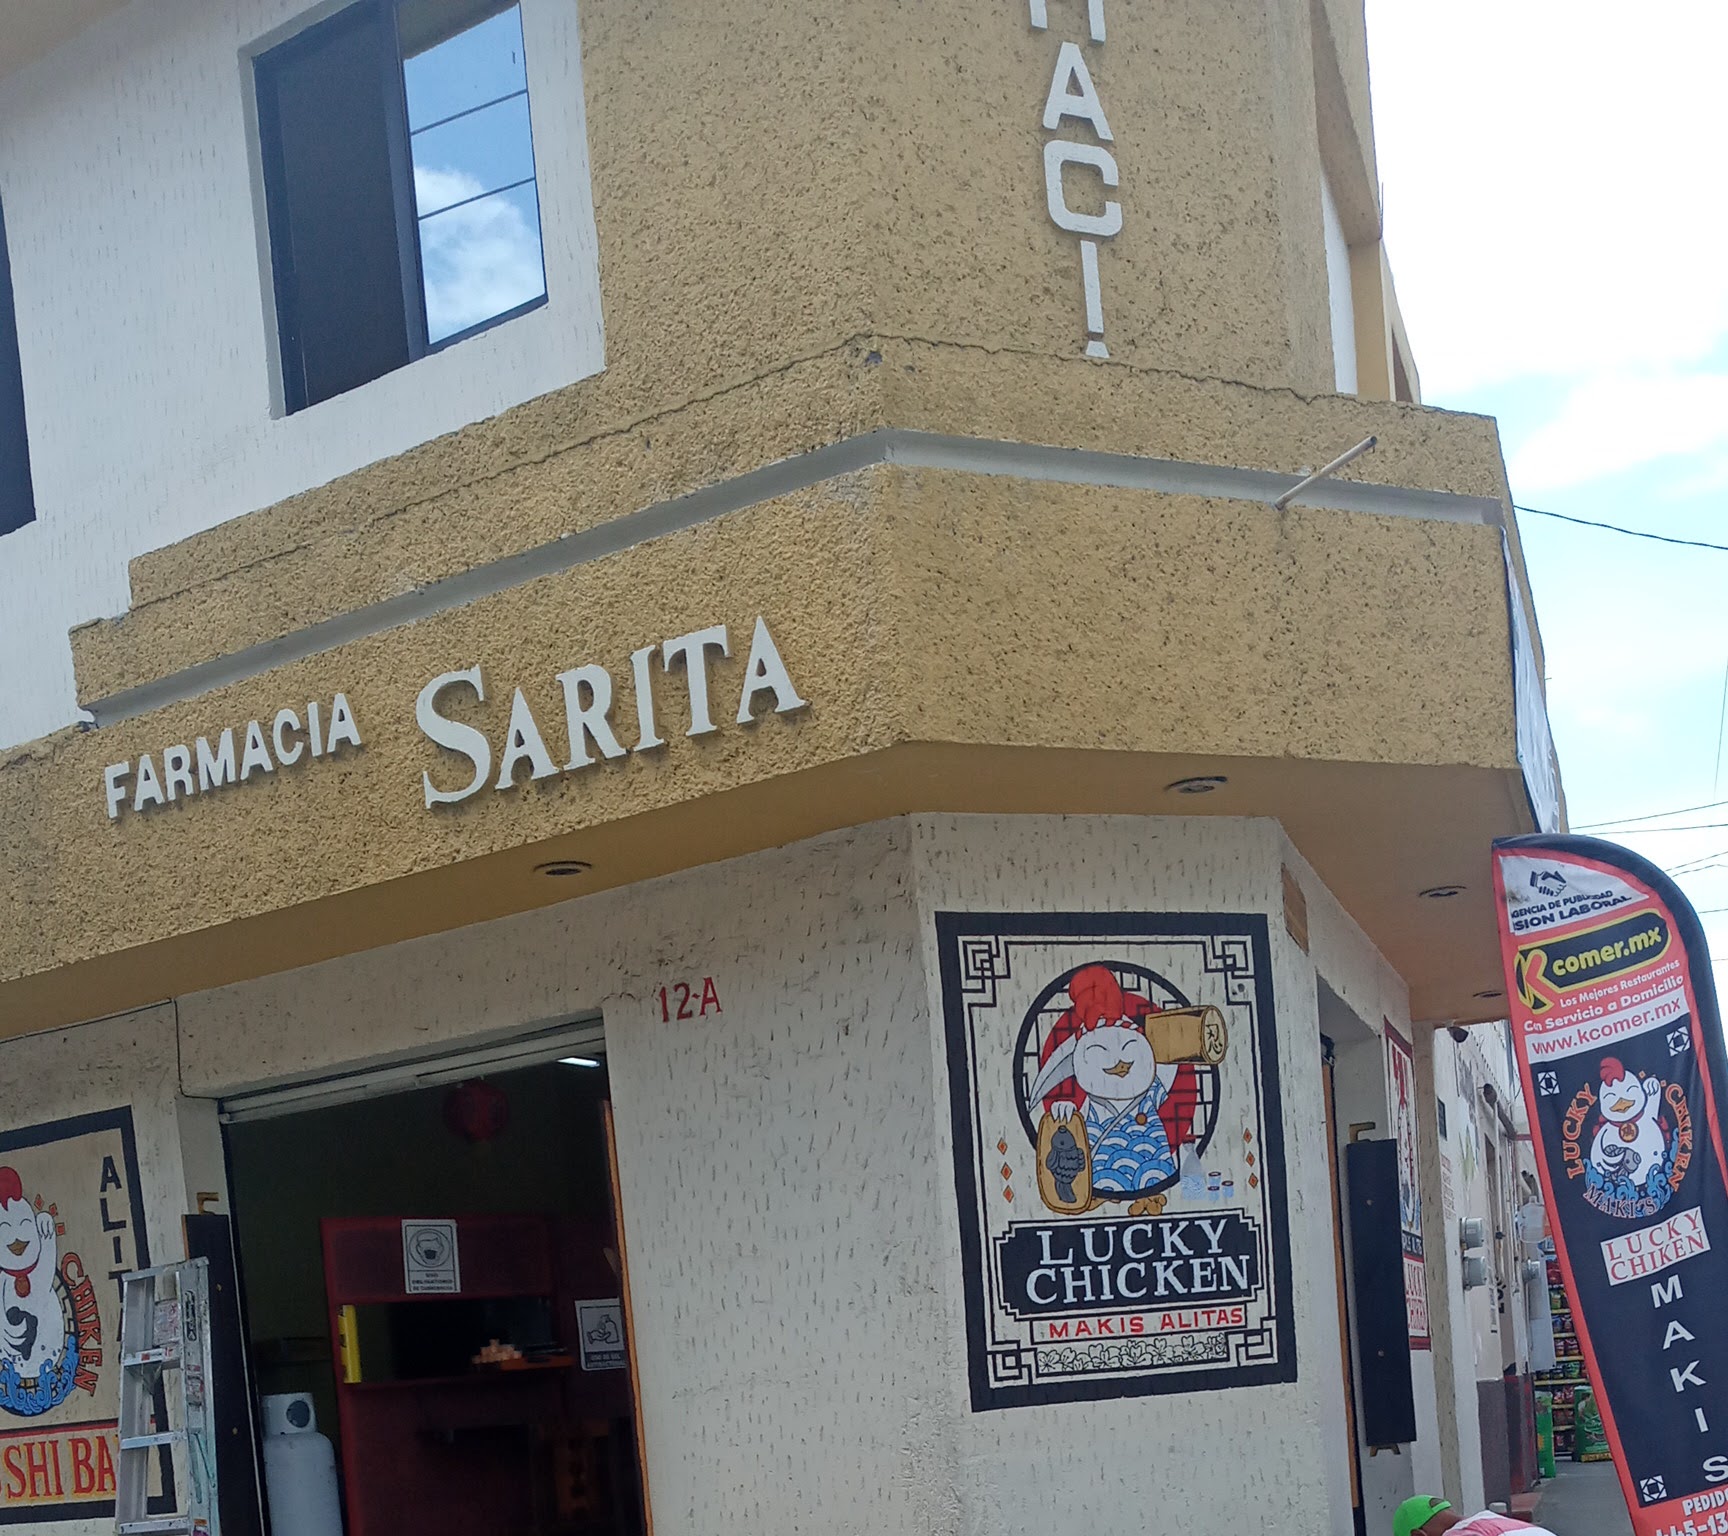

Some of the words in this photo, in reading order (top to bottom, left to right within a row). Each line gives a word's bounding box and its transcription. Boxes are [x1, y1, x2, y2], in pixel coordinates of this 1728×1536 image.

[104, 692, 362, 819] FARMACIA
[414, 614, 809, 810] SARITA
[1548, 900, 1561, 910] DE
[1559, 895, 1632, 920] LABORAL
[659, 976, 723, 1023] 12-A
[1545, 1005, 1604, 1030] Servicio
[1607, 1002, 1618, 1012] a
[1620, 975, 1684, 1008] Domicilio
[1560, 994, 1577, 1008] Los
[1579, 981, 1619, 1003] Mejores
[1620, 959, 1681, 990] Restaurantes
[1531, 997, 1682, 1056] www.kcomer.mx
[1562, 1082, 1598, 1180] LUCKY
[1036, 1218, 1228, 1265] LUCKY
[1605, 1209, 1700, 1262] LUCKY
[1610, 1230, 1705, 1281] CHIKEN
[1026, 1254, 1250, 1305] CHICKEN
[1049, 1316, 1145, 1339] MAKIS
[1160, 1307, 1243, 1331] ALITAS
[0, 1440, 65, 1499] SHI
[68, 1434, 119, 1494] BA
